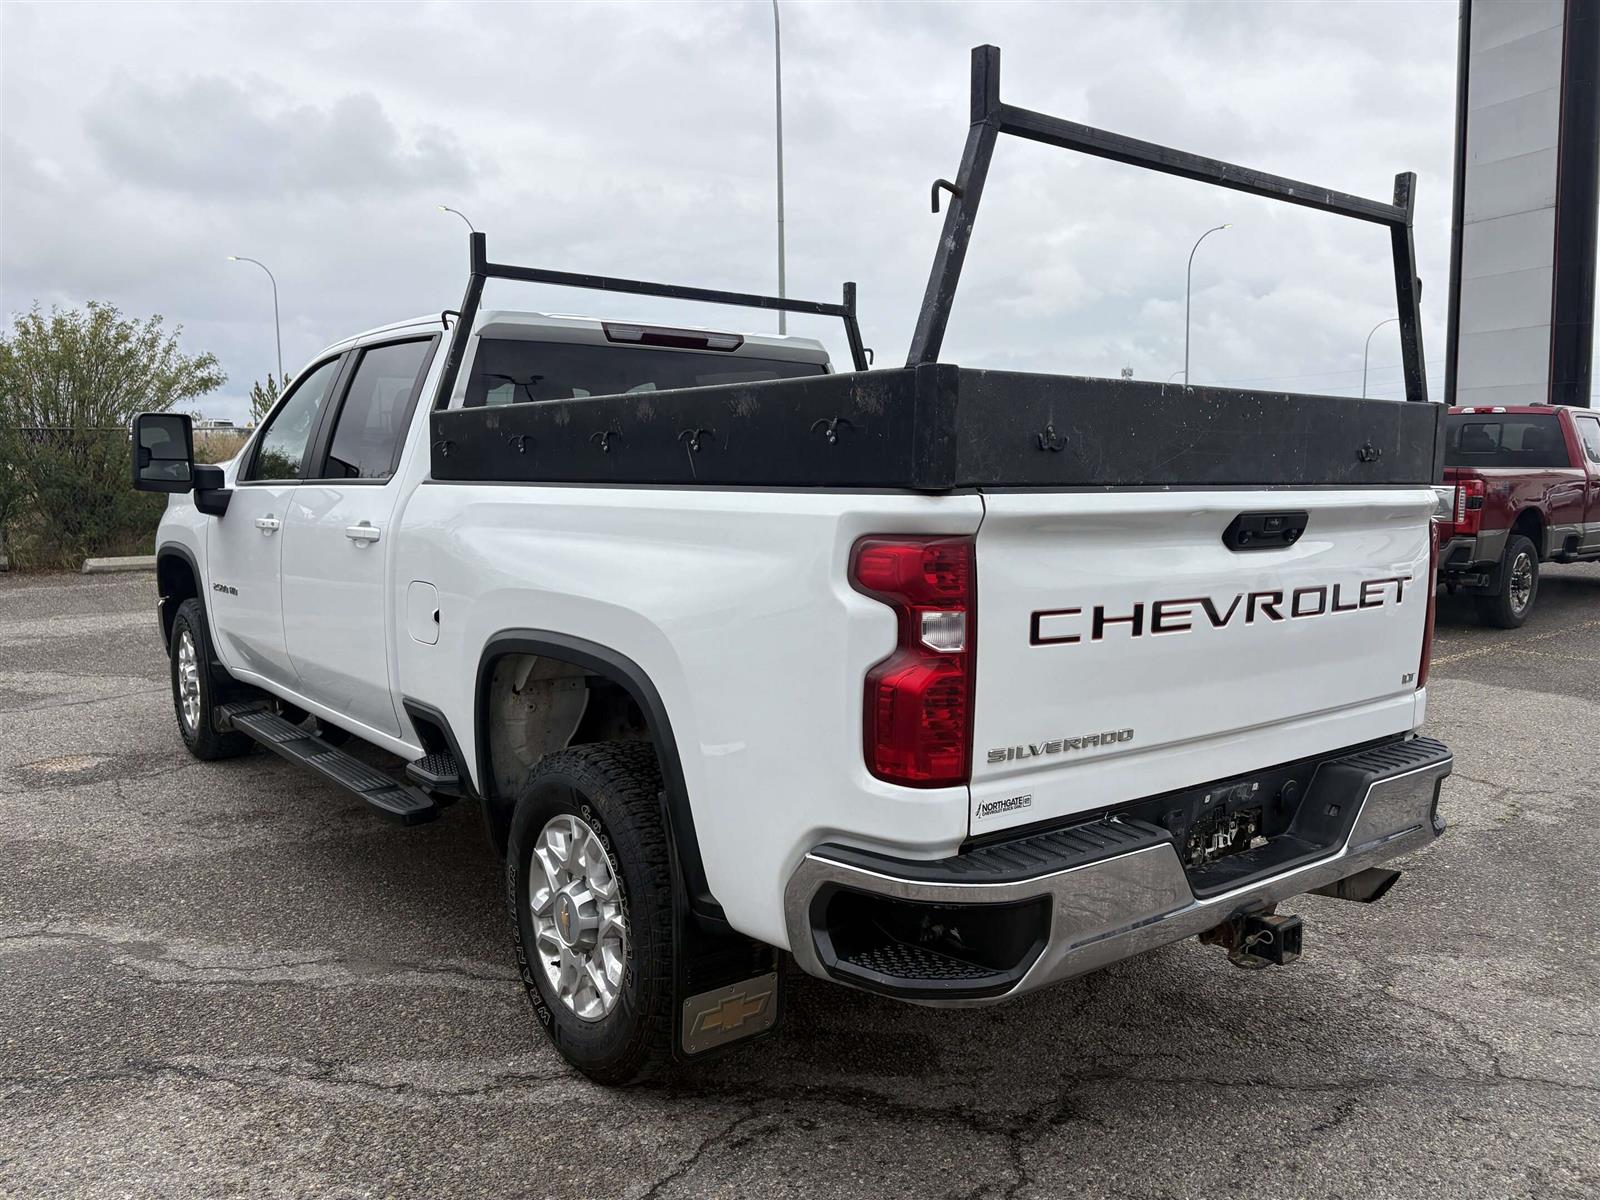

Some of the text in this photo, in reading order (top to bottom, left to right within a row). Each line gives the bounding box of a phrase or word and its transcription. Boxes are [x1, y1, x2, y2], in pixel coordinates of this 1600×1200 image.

[1029, 575, 1413, 647] CHEVROLET
[987, 728, 1134, 763] SILVERADO
[982, 796, 1023, 812] NORTHGATE
